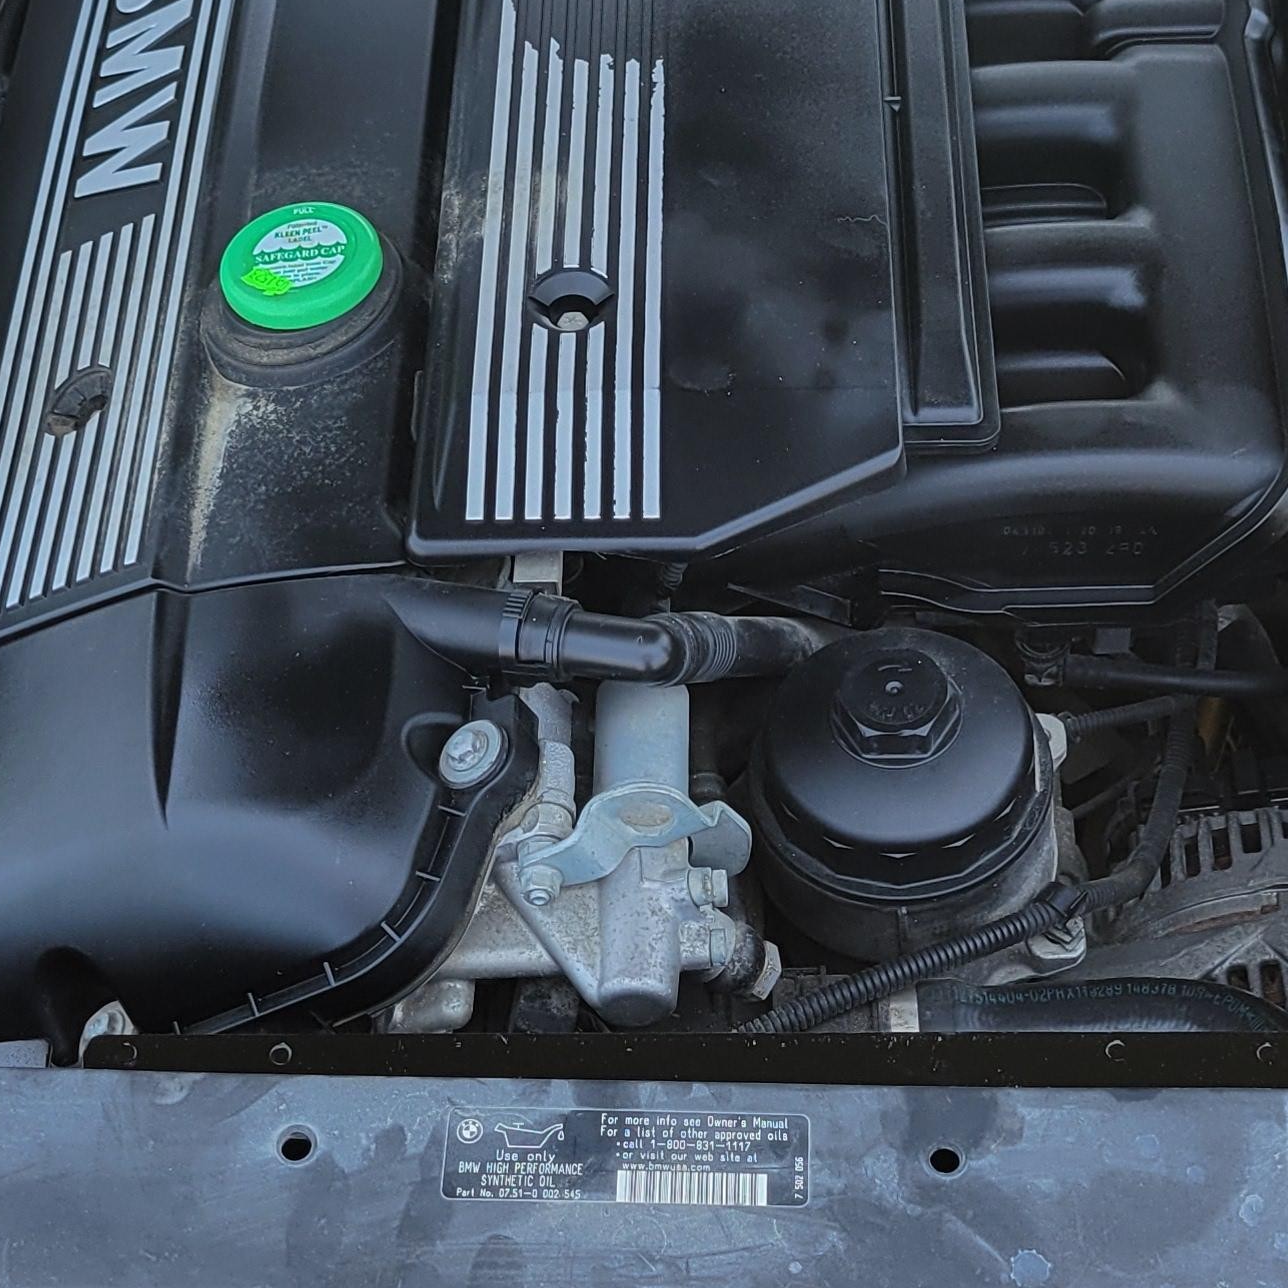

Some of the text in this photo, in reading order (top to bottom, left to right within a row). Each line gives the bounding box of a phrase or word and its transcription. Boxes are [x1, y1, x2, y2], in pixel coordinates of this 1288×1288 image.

[274, 229, 302, 239] KLEEN
[255, 245, 345, 263] SAFEGARD CAP
[601, 1113, 789, 1129] For more info see Owner's Manual
[600, 1125, 788, 1141] For a list of other approved oils
[496, 1149, 556, 1164] Use only
[640, 1150, 665, 1161] visit
[671, 1152, 688, 1161] our
[694, 1151, 714, 1162] web
[719, 1152, 740, 1163] site
[746, 1153, 758, 1163] at
[458, 1161, 584, 1176] BMW HIGH PERFORMANCE
[622, 1161, 711, 1172] www.bmwusa.com
[480, 1174, 556, 1188] SYNTHETIC OIL
[794, 1156, 804, 1200] 7 502 056
[456, 1187, 475, 1197] Part
[480, 1187, 494, 1198] No.
